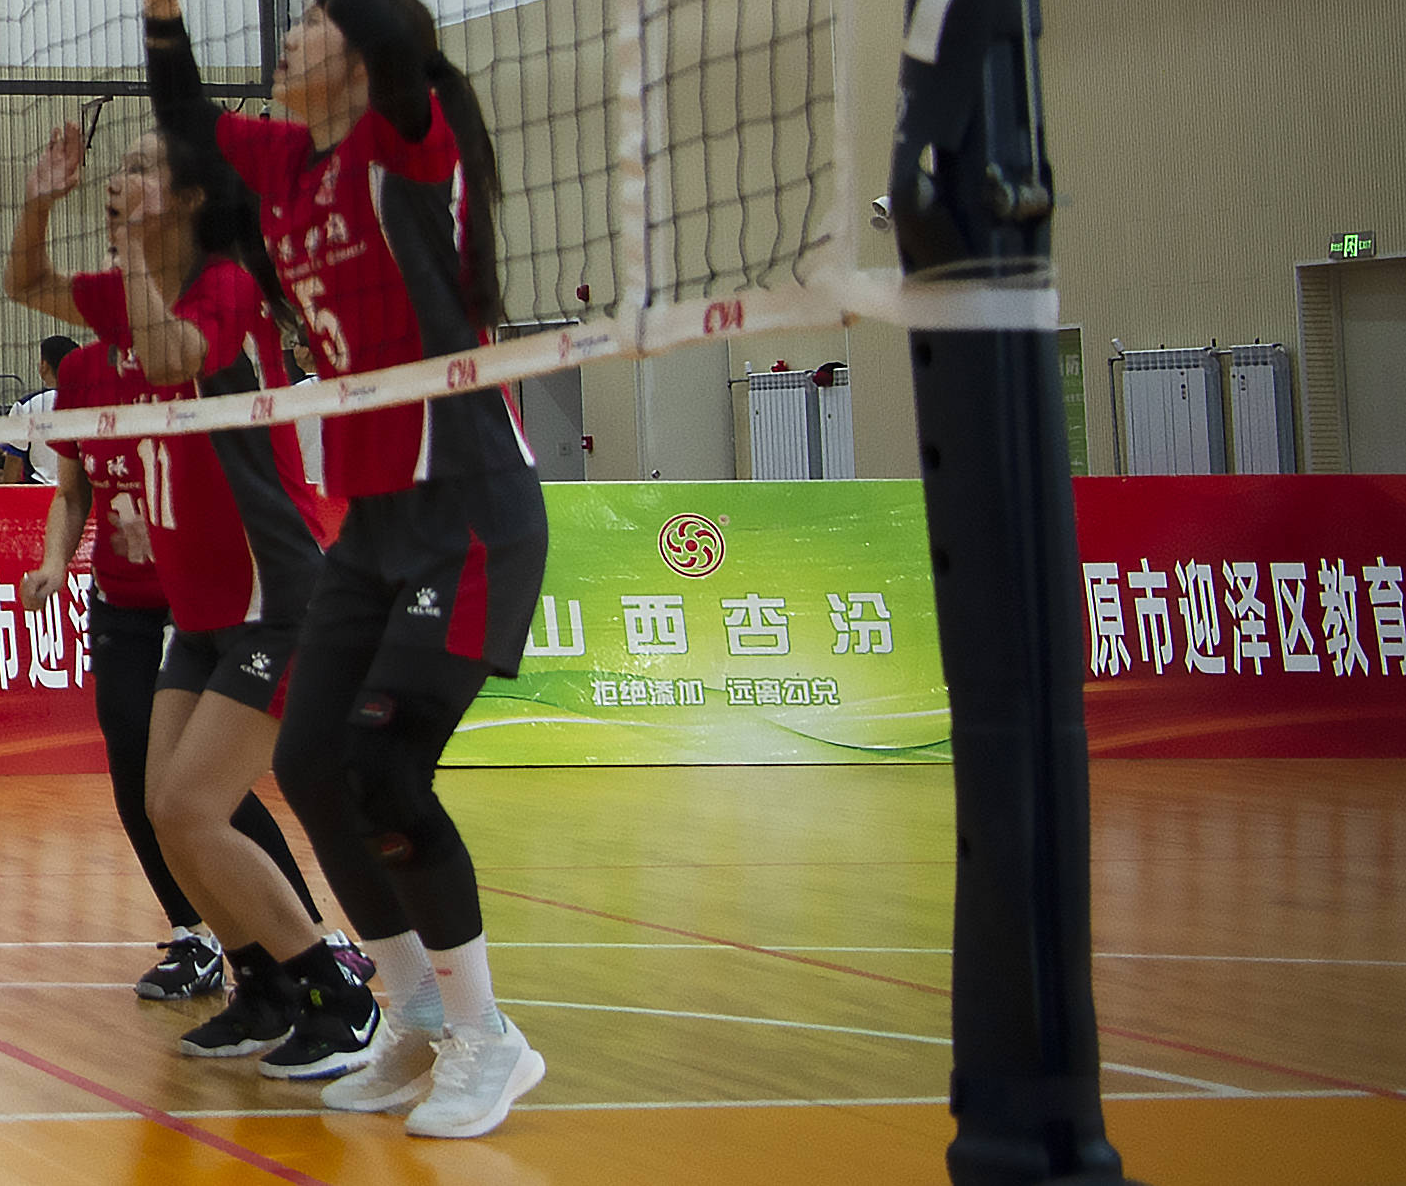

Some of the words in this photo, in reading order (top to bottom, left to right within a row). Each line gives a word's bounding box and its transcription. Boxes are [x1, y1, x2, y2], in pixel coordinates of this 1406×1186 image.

[524, 592, 895, 657] 山西杏汾
[590, 678, 705, 707] 拒绝添加
[726, 678, 841, 707] 远离勾兑
